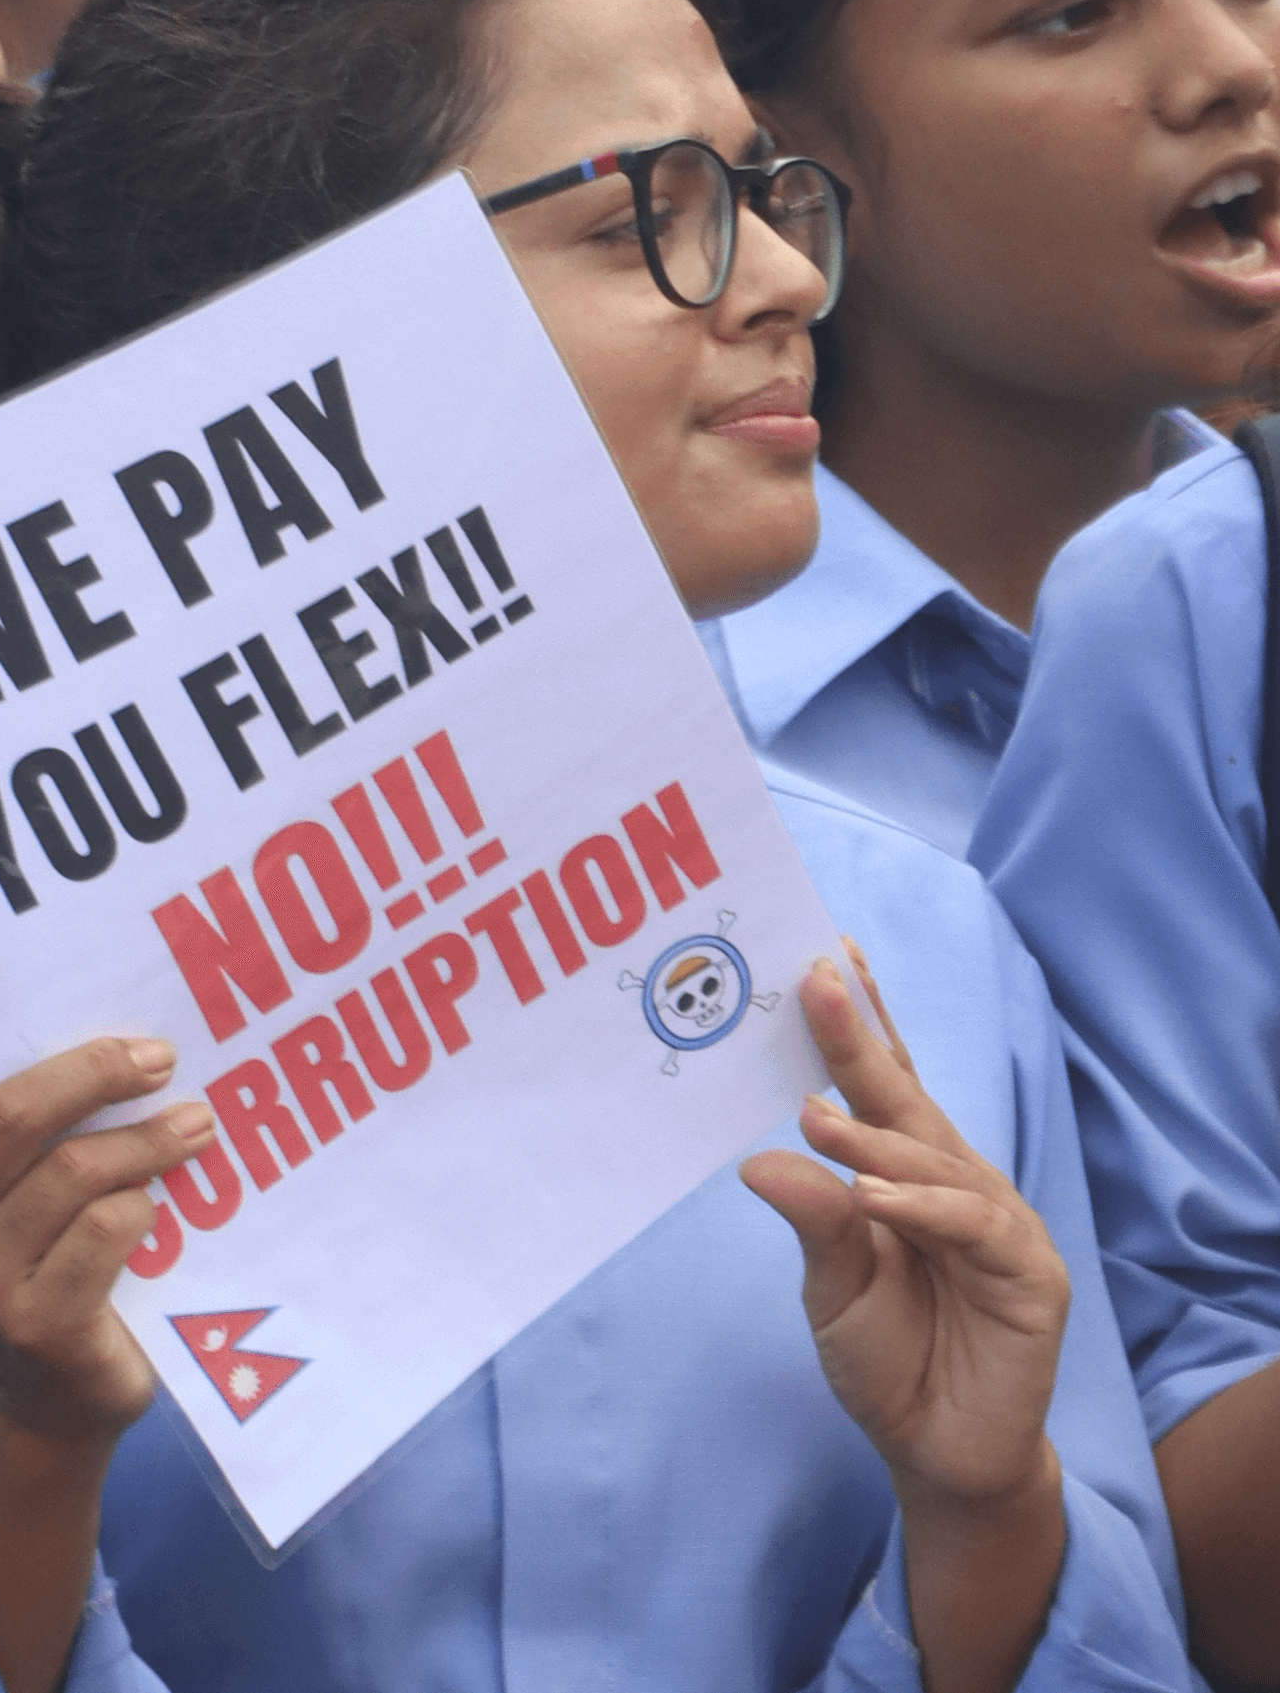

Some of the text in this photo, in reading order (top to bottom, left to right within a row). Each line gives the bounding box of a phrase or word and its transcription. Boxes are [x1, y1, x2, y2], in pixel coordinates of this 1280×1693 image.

[112, 356, 386, 609] PAY
[181, 505, 534, 792] FLEX!!
[151, 728, 508, 1045] NO!!!
